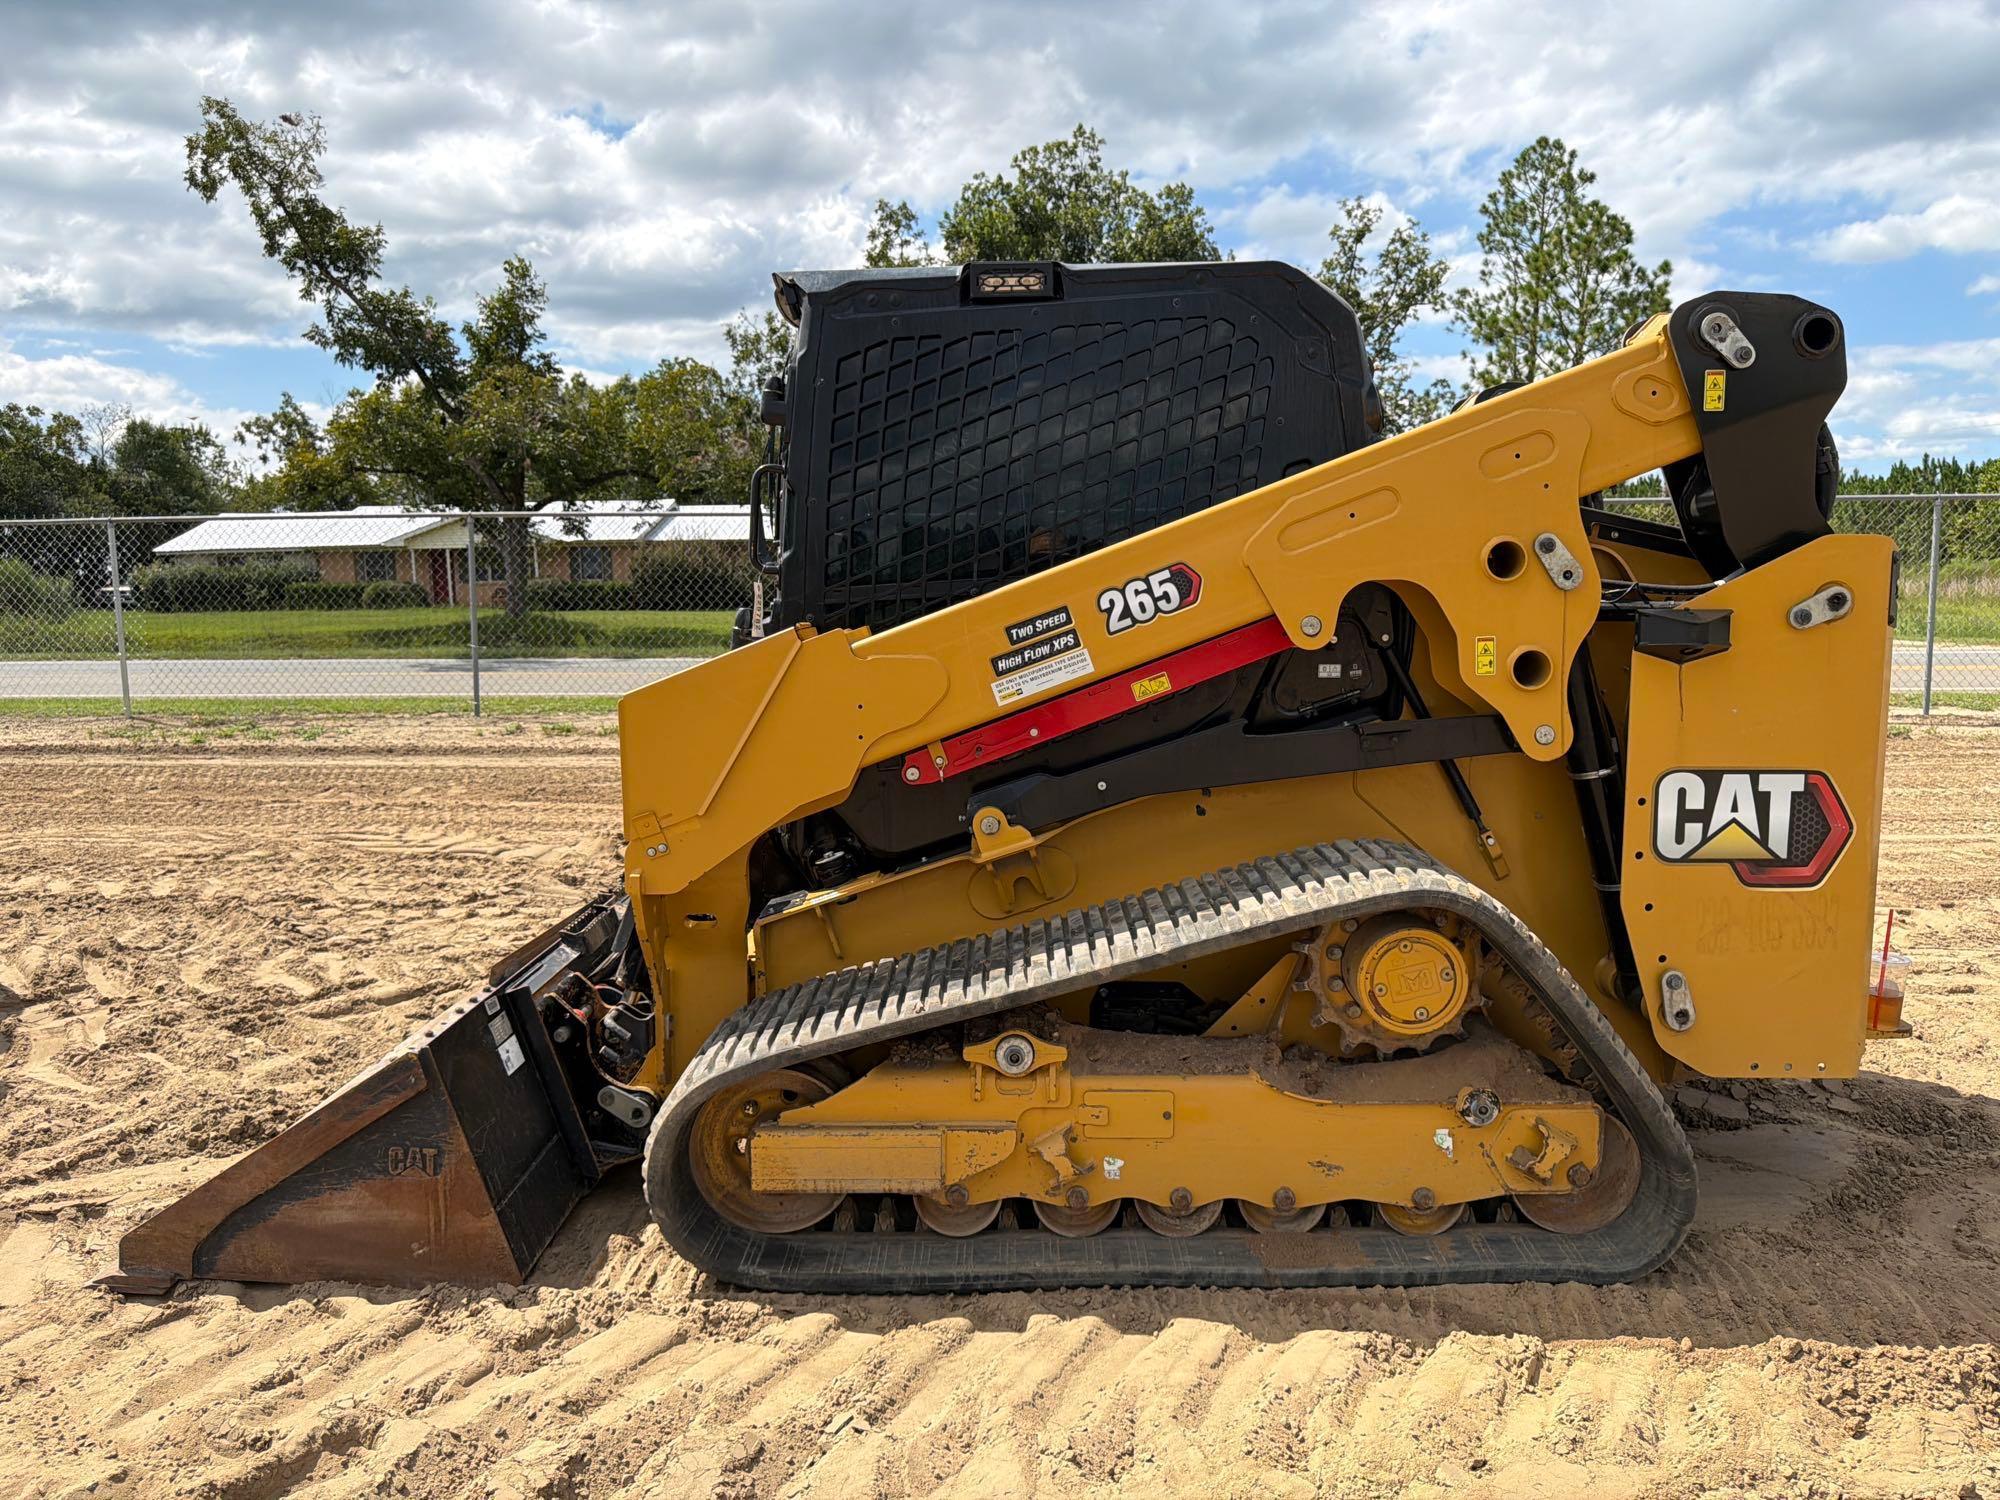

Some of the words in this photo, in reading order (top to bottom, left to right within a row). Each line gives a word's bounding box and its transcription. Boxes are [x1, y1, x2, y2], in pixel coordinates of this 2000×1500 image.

[1100, 569, 1180, 633] 265
[1010, 625, 1034, 640] TWO
[1035, 612, 1067, 632] SPEED
[997, 654, 1022, 671] HIGH
[1024, 644, 1050, 662] FLOW
[1053, 634, 1075, 652] XPS
[1656, 771, 1806, 860] CAT
[388, 1146, 438, 1177] CAT
